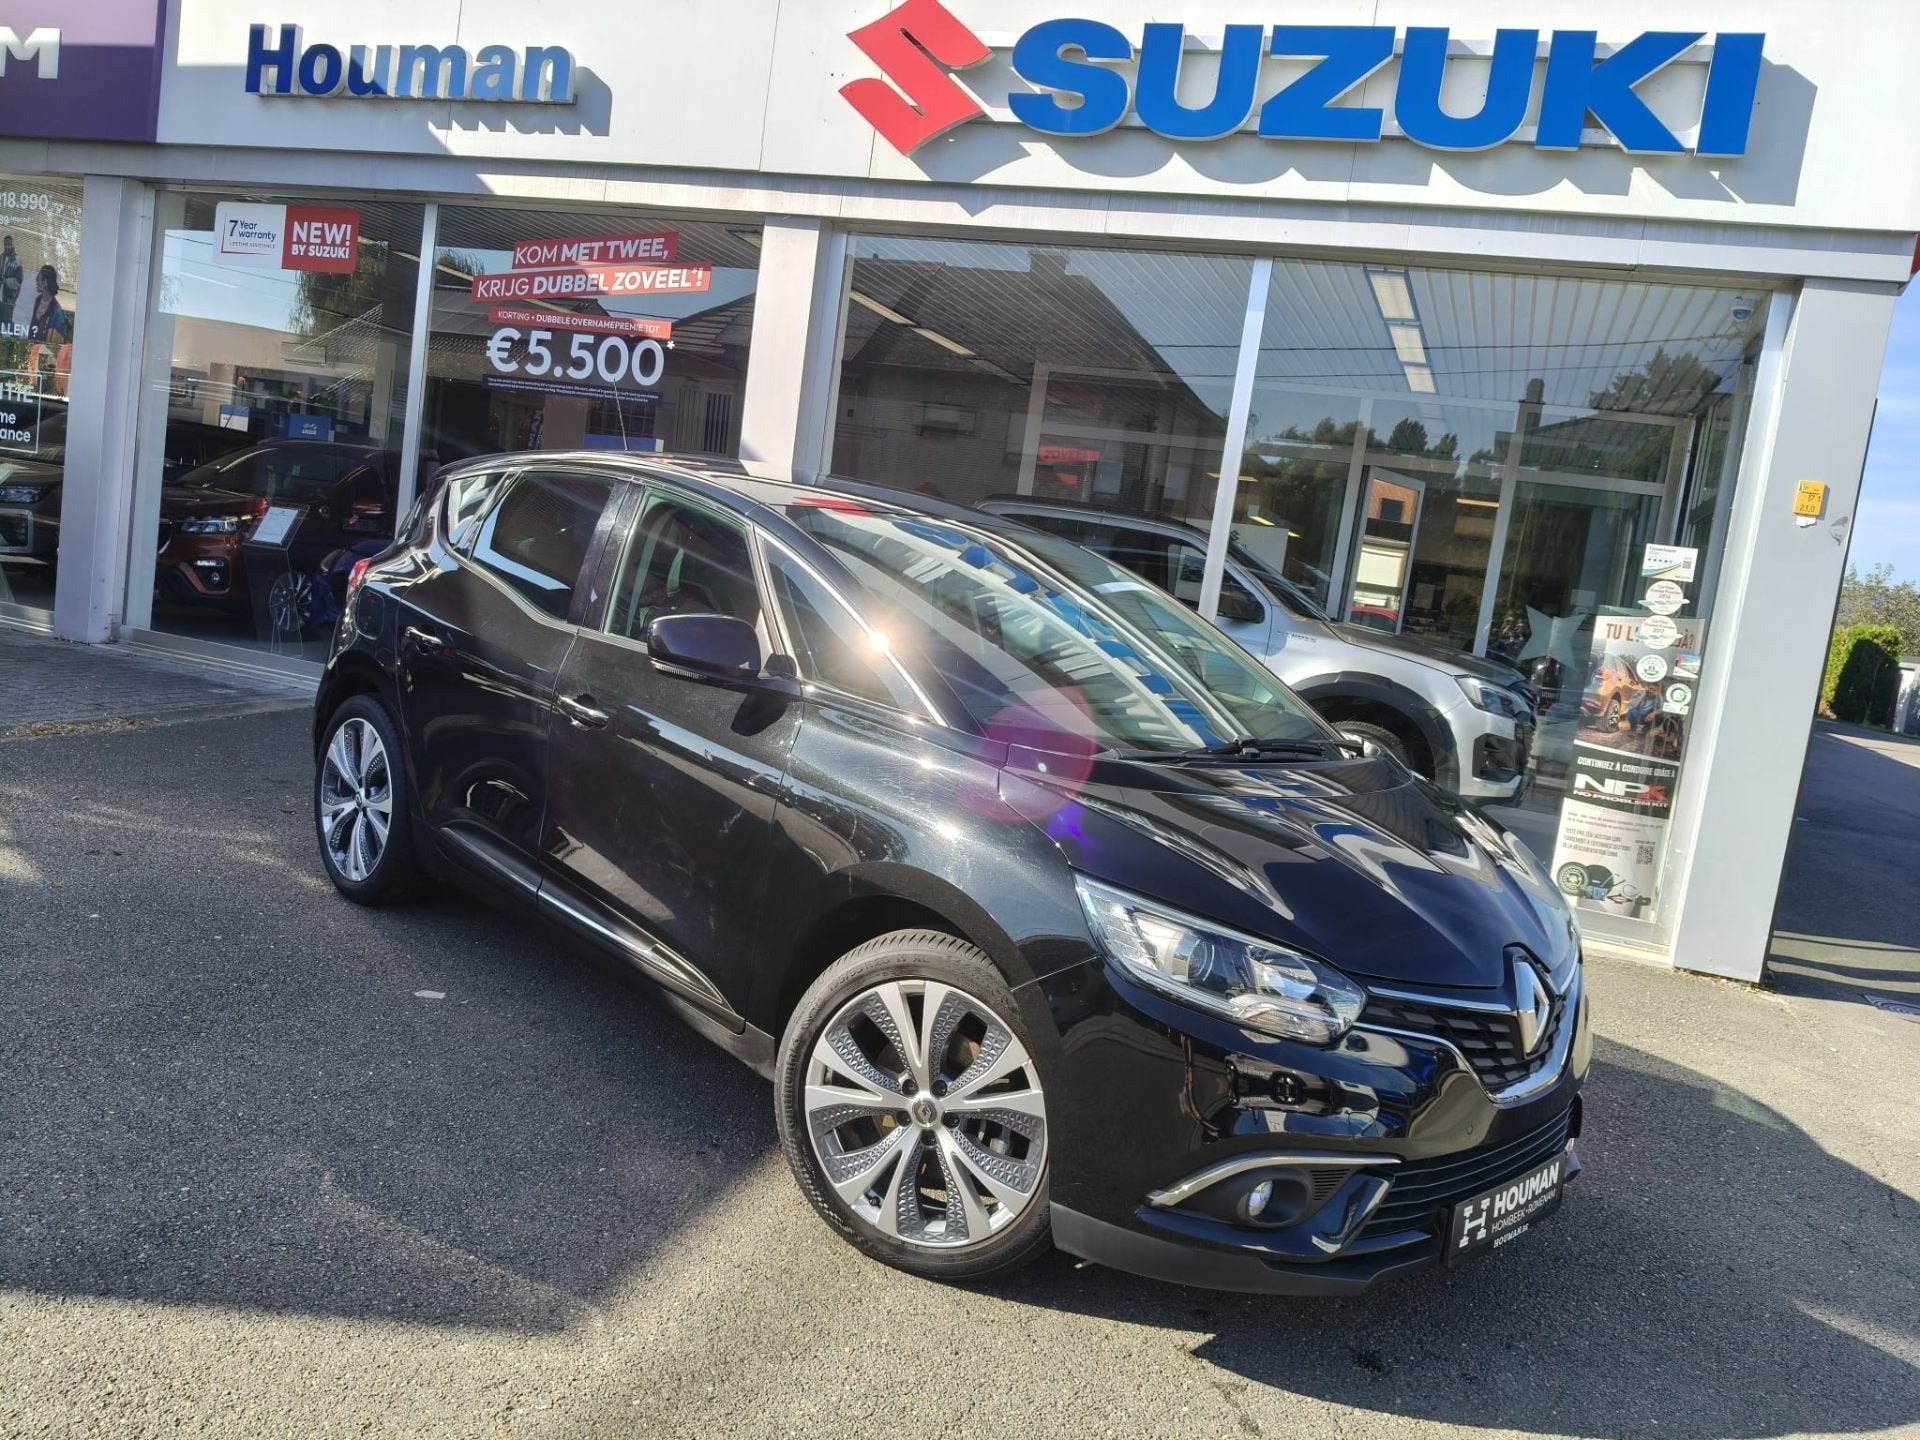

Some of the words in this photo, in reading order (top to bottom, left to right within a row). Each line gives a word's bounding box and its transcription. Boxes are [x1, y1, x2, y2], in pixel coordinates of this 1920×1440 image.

[245, 23, 576, 102] Houman
[1008, 17, 1766, 156] SUZUKI
[0, 191, 49, 211] 18.990
[229, 219, 239, 237] 7
[239, 220, 258, 231] Year
[238, 229, 277, 243] warranty
[292, 221, 352, 246] NEW!
[291, 243, 306, 256] BY
[307, 246, 350, 259] SUZUKI
[515, 246, 557, 265] KOM
[560, 242, 604, 262] MET
[606, 237, 669, 260] TWEE,
[477, 277, 529, 298] KRIJG
[532, 272, 609, 294] DUBBEL
[498, 311, 530, 322] KORTING
[536, 314, 571, 325] DUBBELE
[0, 322, 30, 338] LLEN
[1606, 623, 1622, 640] TU
[1577, 756, 1614, 771] CONTINUEZ
[1493, 1161, 1560, 1218] HOUMAN
[1491, 1208, 1526, 1234] HOMBEEK
